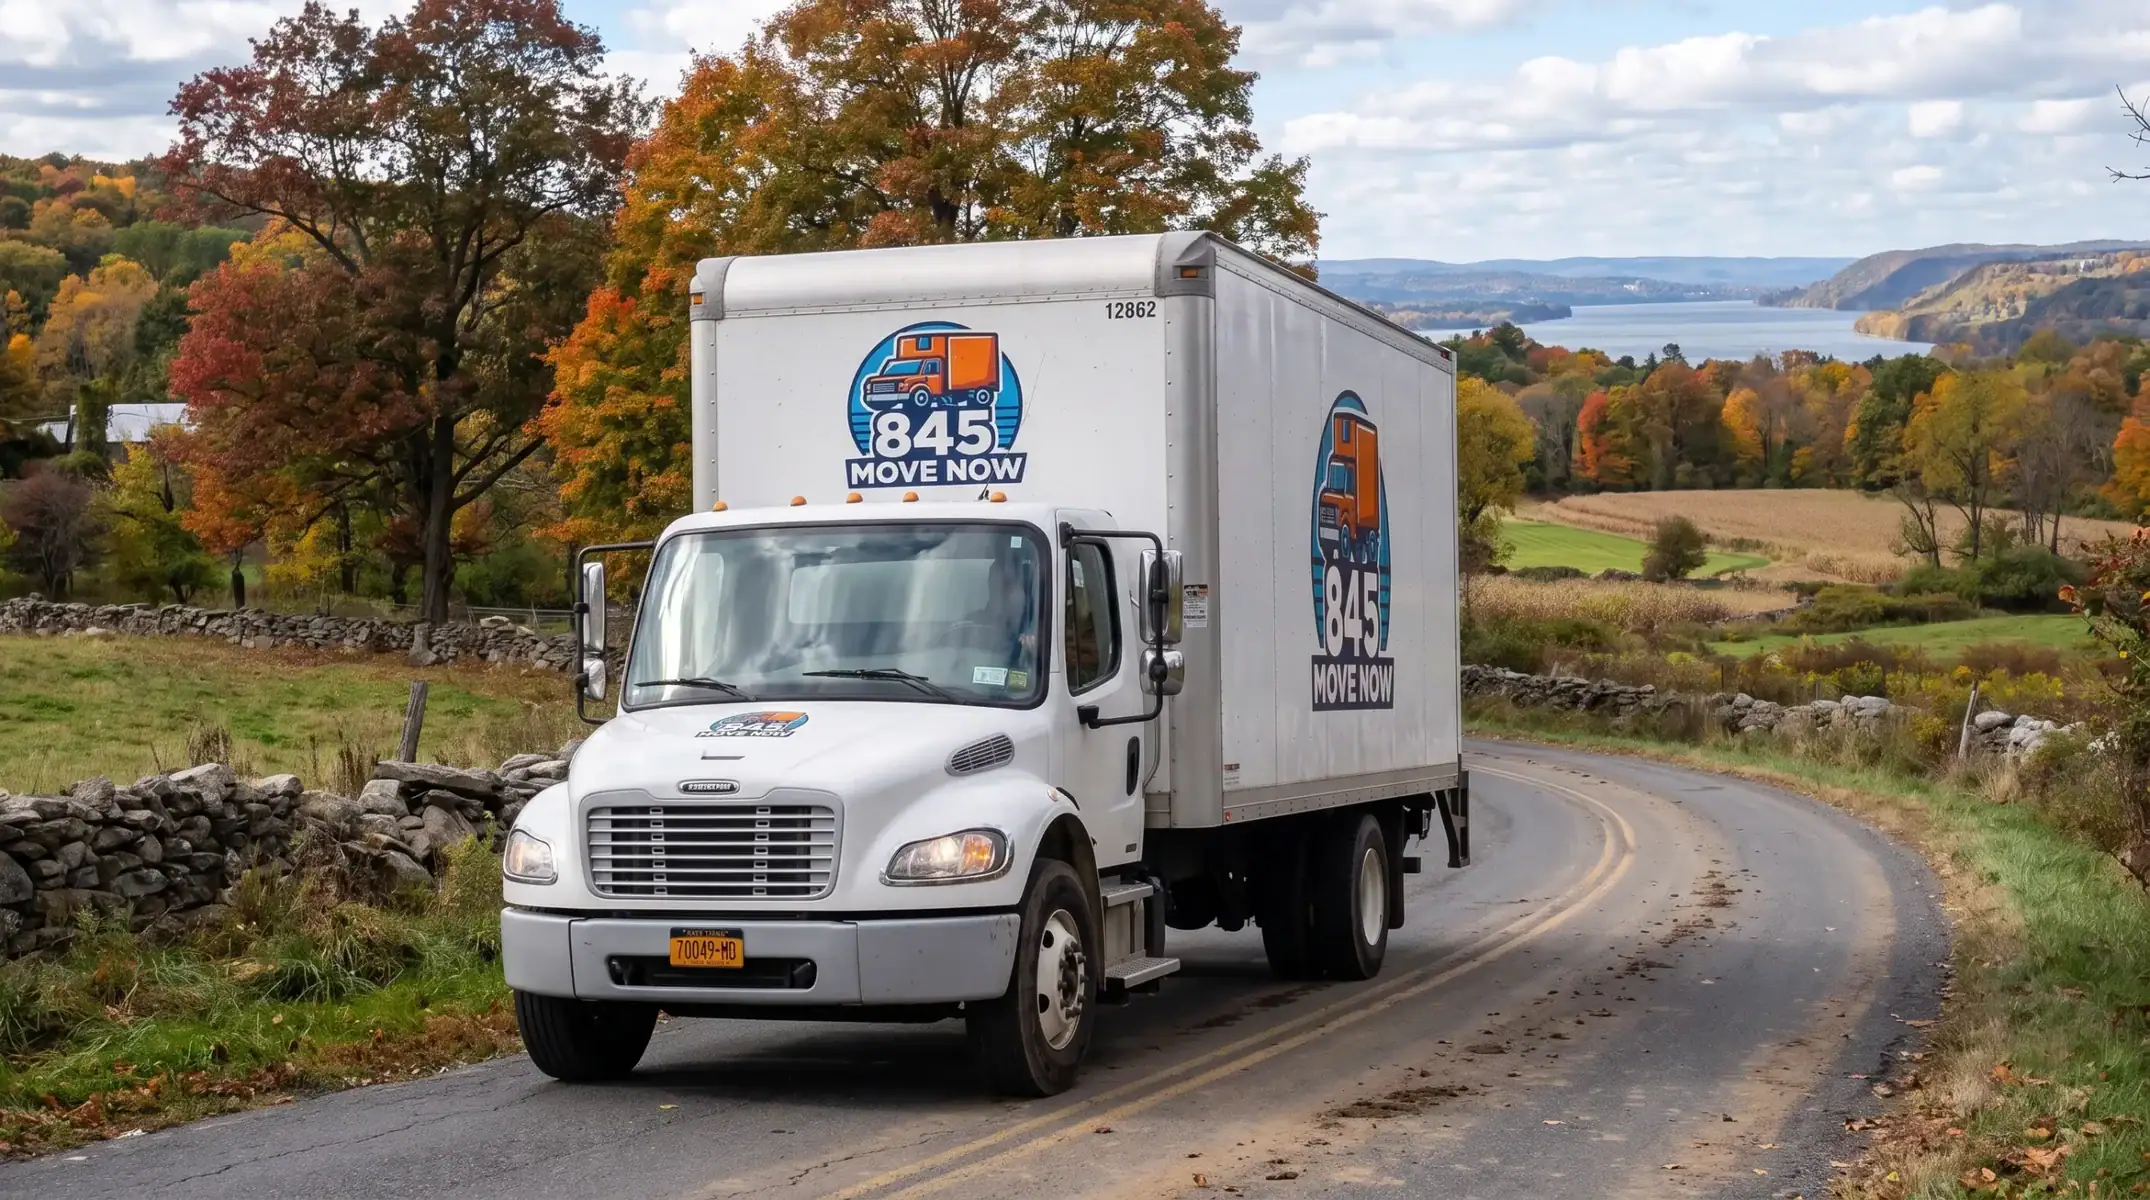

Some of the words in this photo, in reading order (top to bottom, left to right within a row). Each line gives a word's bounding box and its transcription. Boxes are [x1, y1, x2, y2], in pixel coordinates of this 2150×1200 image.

[1105, 301, 1156, 319] 12862
[875, 410, 992, 458] 845
[851, 460, 938, 485] MOVE
[946, 457, 1023, 482] NOW
[1326, 565, 1379, 658] 845
[1314, 663, 1357, 704] MOVE
[1359, 664, 1393, 703] NOW
